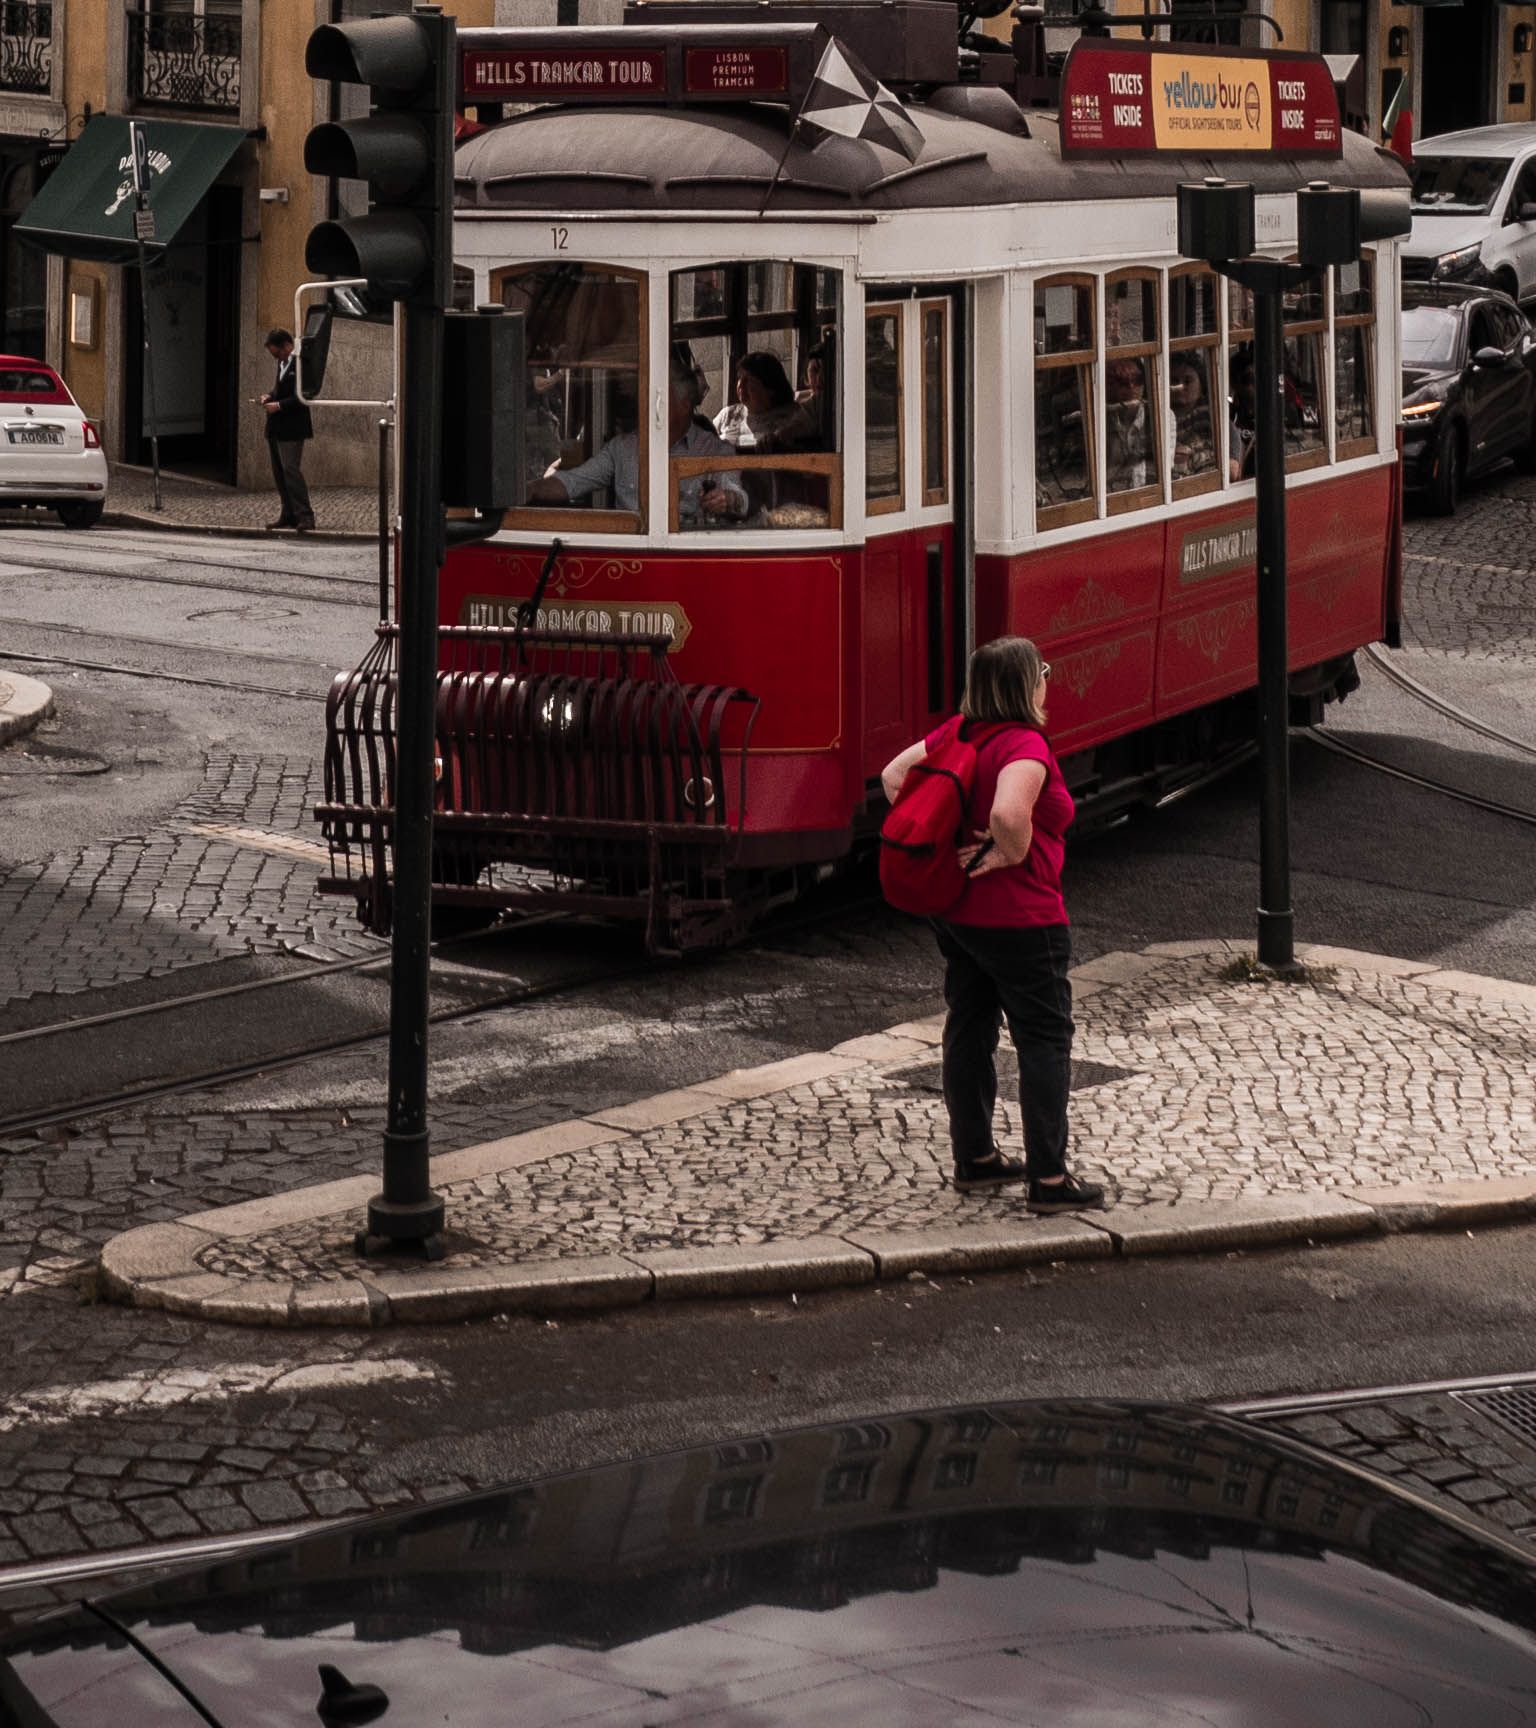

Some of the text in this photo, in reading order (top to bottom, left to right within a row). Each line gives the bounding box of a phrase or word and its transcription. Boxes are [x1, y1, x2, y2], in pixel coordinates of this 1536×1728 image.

[716, 53, 750, 63] LISBON
[476, 61, 653, 84] HILLS TRAMCAR TOUR
[712, 65, 754, 75] PREMIUM
[713, 77, 754, 88] TRAMCAR
[1108, 73, 1144, 95] TICKETS
[1218, 72, 1242, 110] bus
[1277, 80, 1306, 101] TICKETS
[1113, 104, 1142, 127] INSIDE
[1168, 117, 1191, 130] OFFICIAL
[1225, 118, 1243, 131] TOURS
[1281, 110, 1305, 129] INSIDE
[551, 227, 568, 249] 12
[1183, 540, 1207, 572] HILLS
[470, 603, 676, 639] HILLS RAMCAR TOUR
